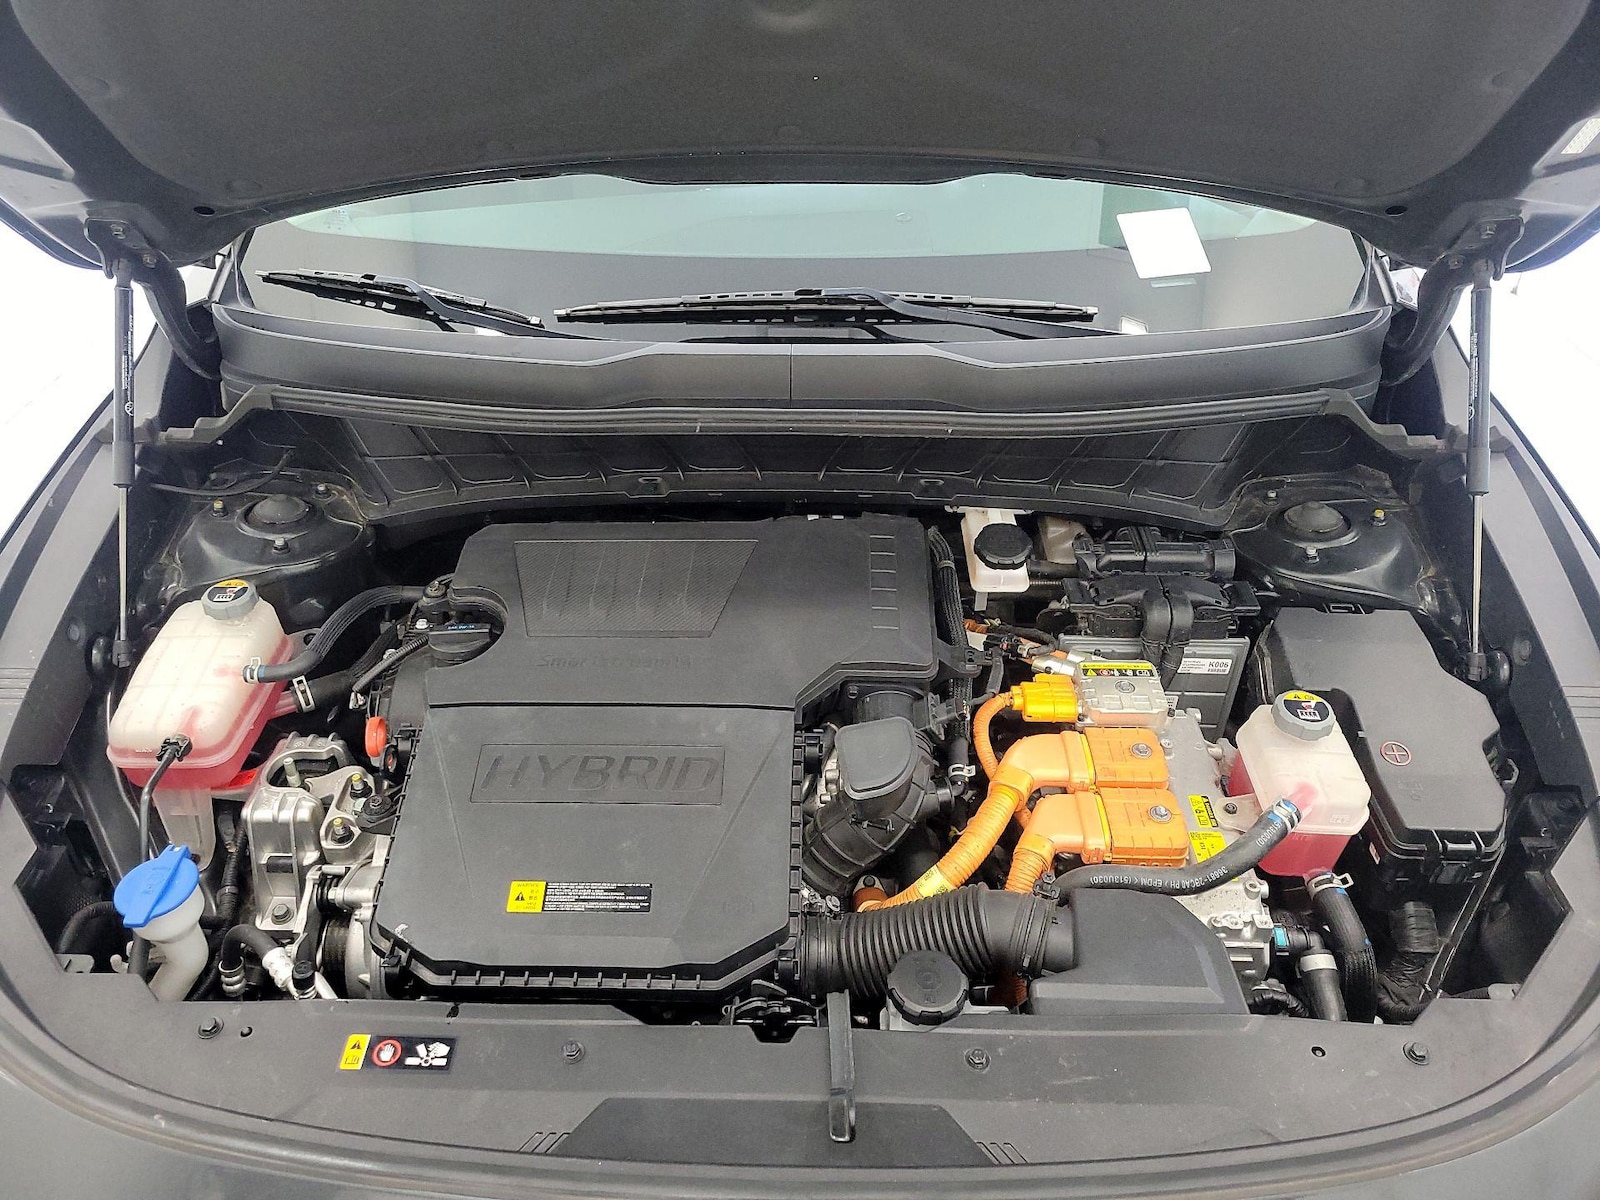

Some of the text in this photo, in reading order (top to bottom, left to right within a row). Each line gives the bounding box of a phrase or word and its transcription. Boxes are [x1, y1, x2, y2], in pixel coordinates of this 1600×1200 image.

[480, 754, 720, 791] HYBRID
[1090, 876, 1132, 885] (513U030)
[1141, 877, 1162, 888] EPDM
[1170, 880, 1180, 889] PH
